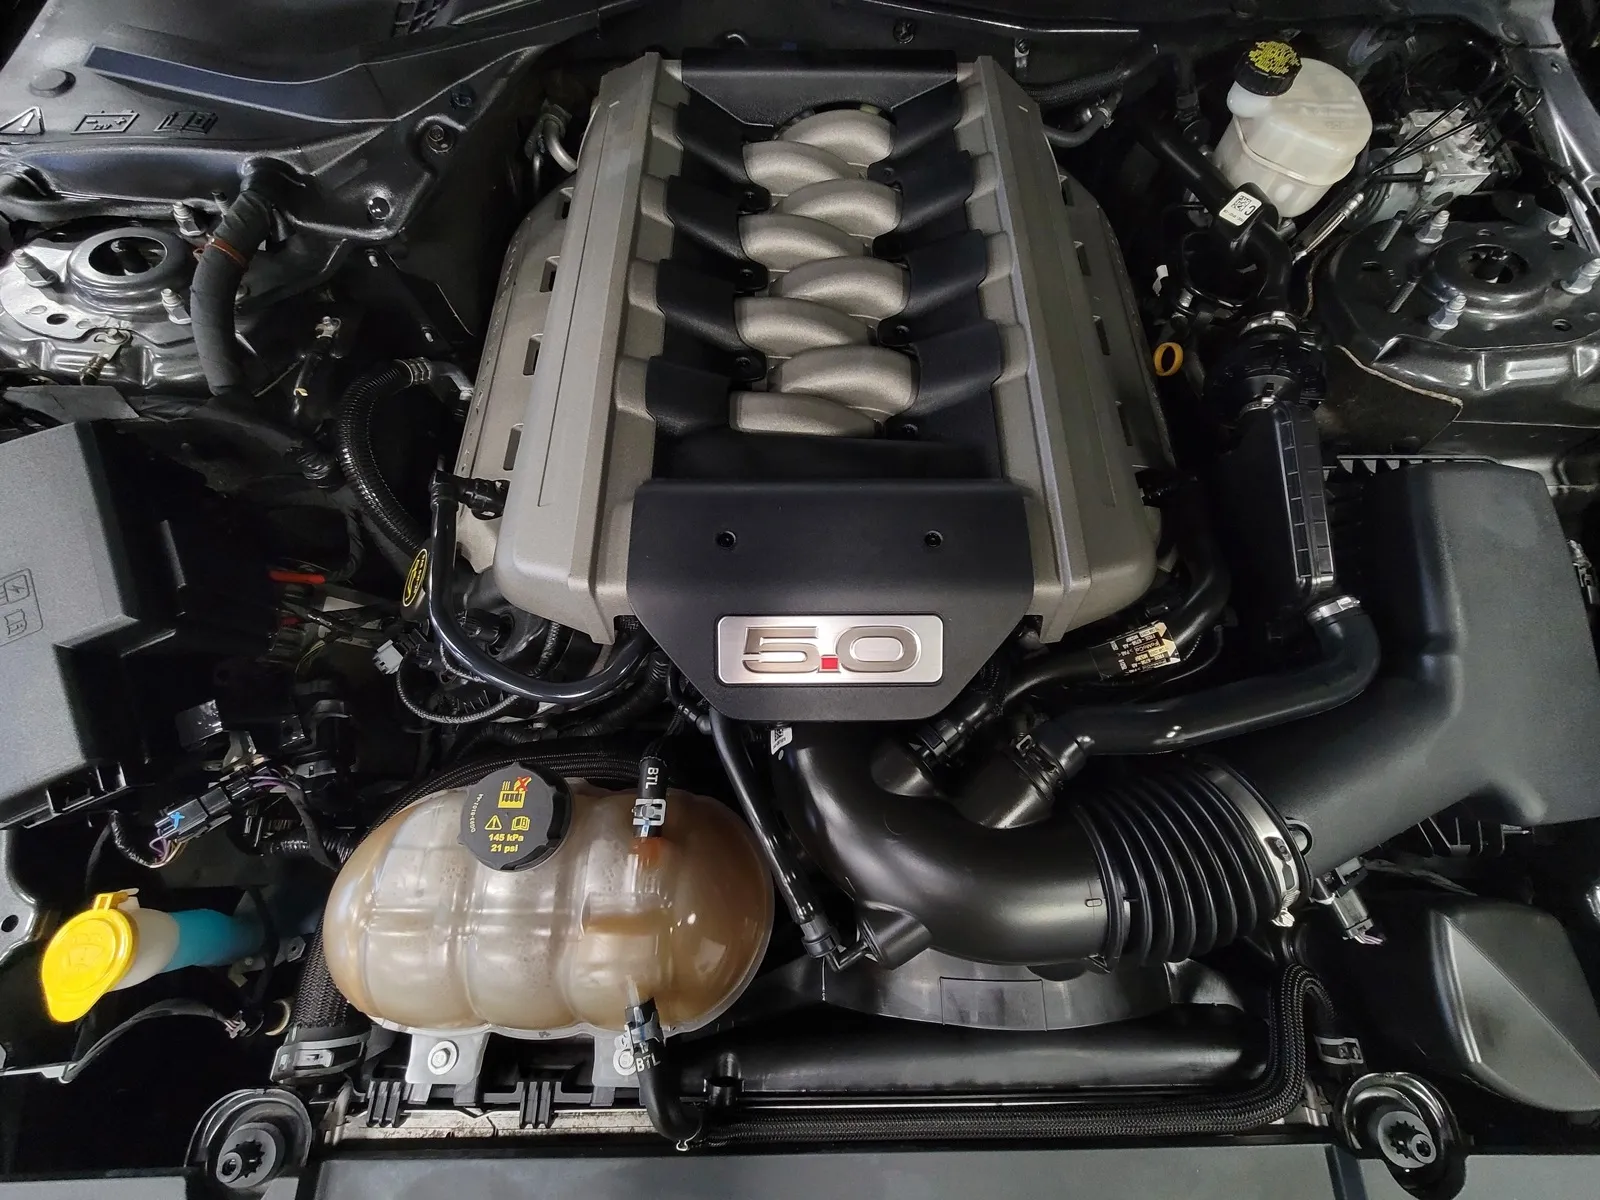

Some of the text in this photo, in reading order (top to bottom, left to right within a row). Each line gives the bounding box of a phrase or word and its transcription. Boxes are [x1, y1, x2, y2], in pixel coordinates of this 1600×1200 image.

[92, 123, 113, 131] 12V
[741, 624, 923, 674] 5.0
[645, 767, 660, 789] BTL
[488, 833, 524, 842] 145 kPa
[490, 844, 518, 854] 21 psi
[635, 1052, 661, 1073] BTL
